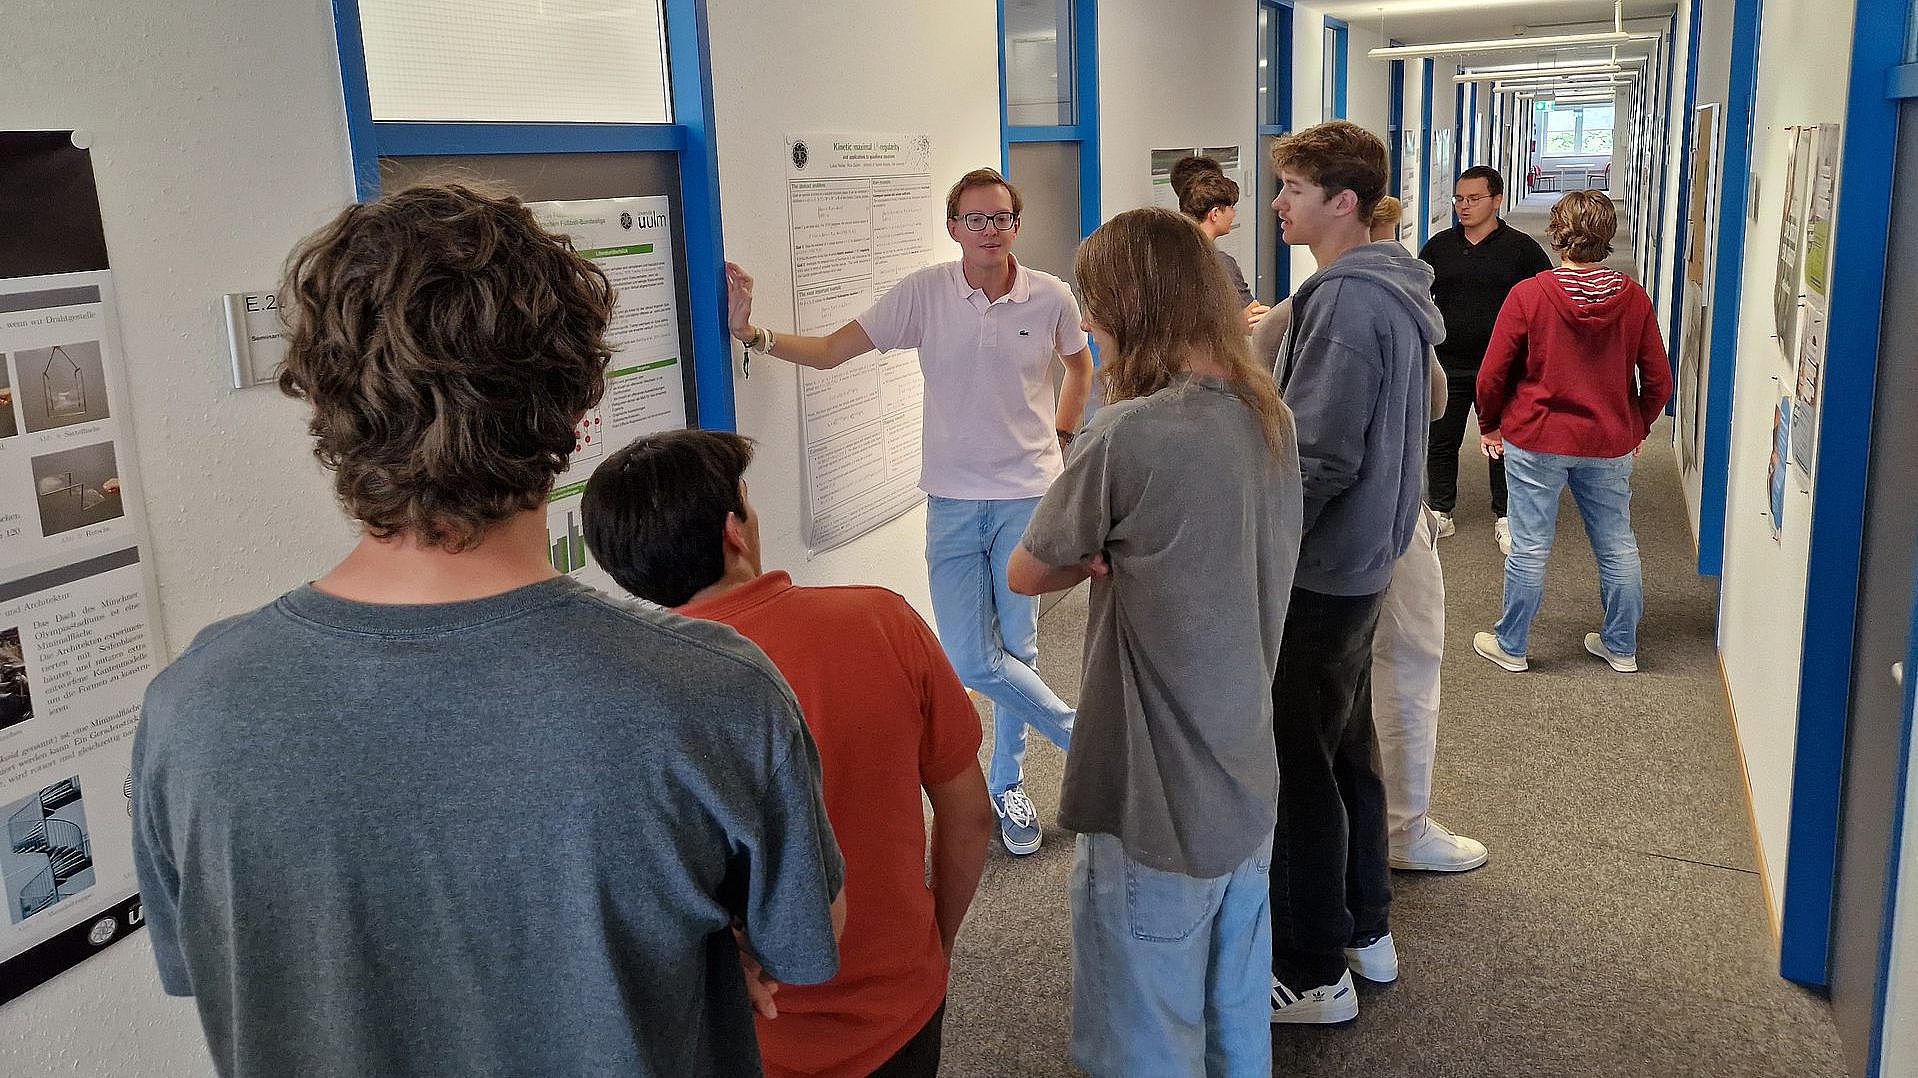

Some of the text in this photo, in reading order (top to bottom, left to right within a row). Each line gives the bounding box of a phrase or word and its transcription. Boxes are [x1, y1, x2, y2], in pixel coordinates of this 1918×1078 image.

[638, 210, 667, 229] uulm
[246, 294, 278, 312] E.2
[58, 637, 102, 656] Architekten
[78, 680, 108, 694] Formen
